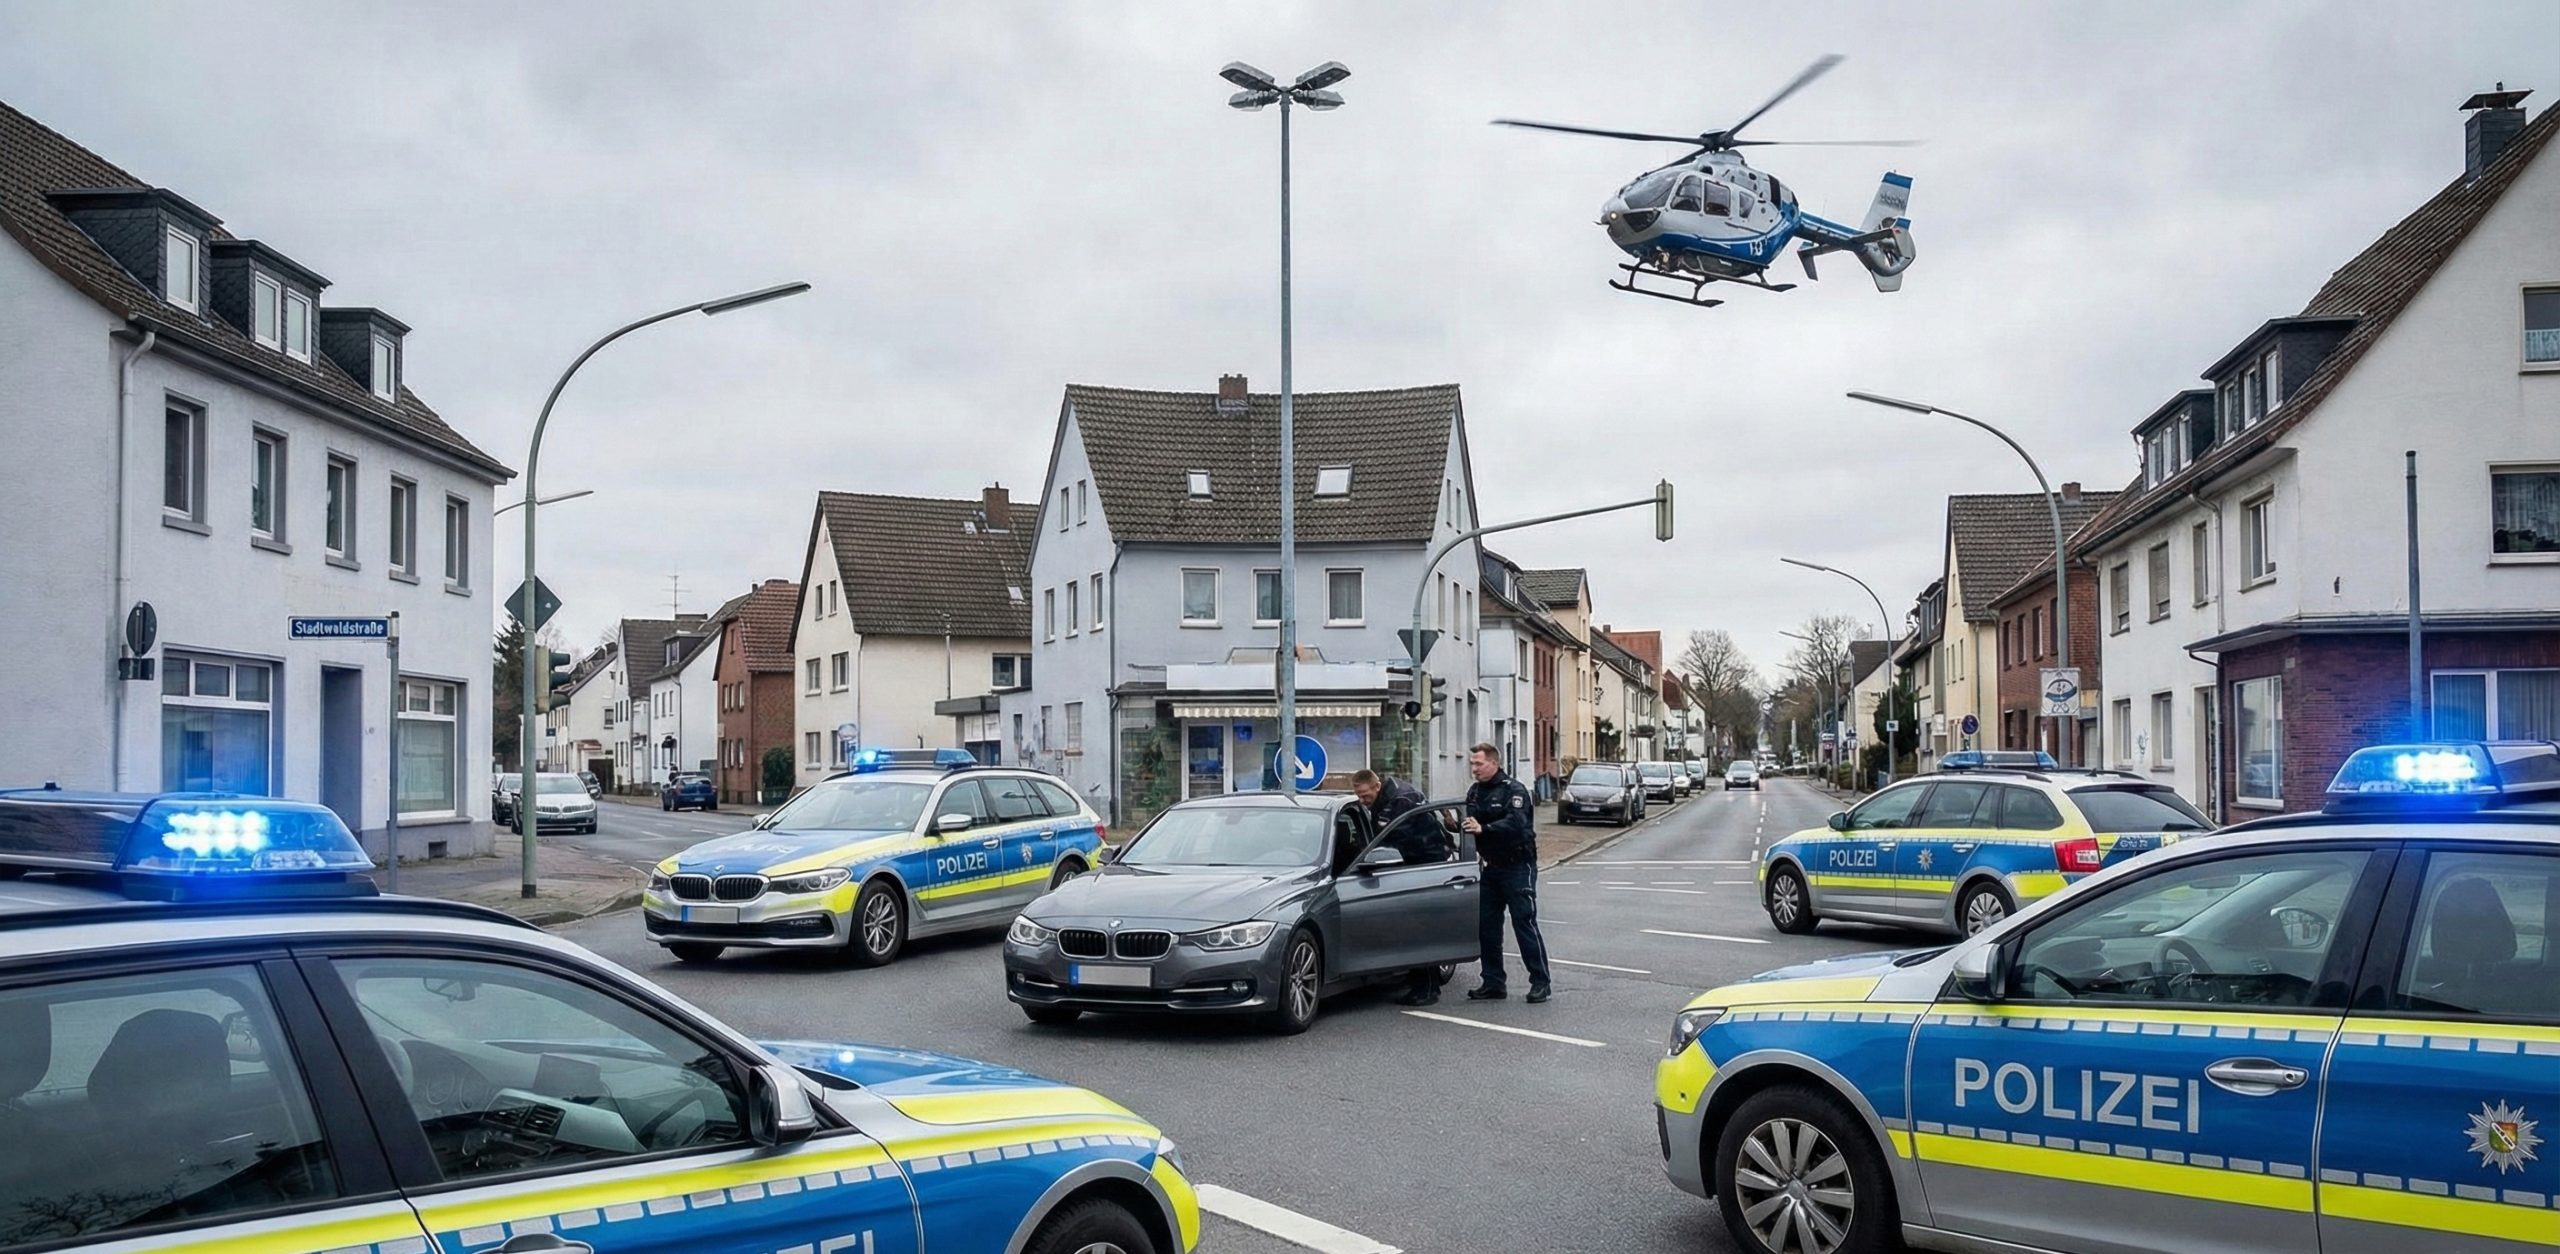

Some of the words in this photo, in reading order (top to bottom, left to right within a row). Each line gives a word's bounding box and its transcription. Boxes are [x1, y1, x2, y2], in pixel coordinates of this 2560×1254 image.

[937, 851, 988, 876] POLIZEI
[1829, 849, 1877, 867] POLIZEI
[1955, 1057, 2200, 1134] POLIZEI
